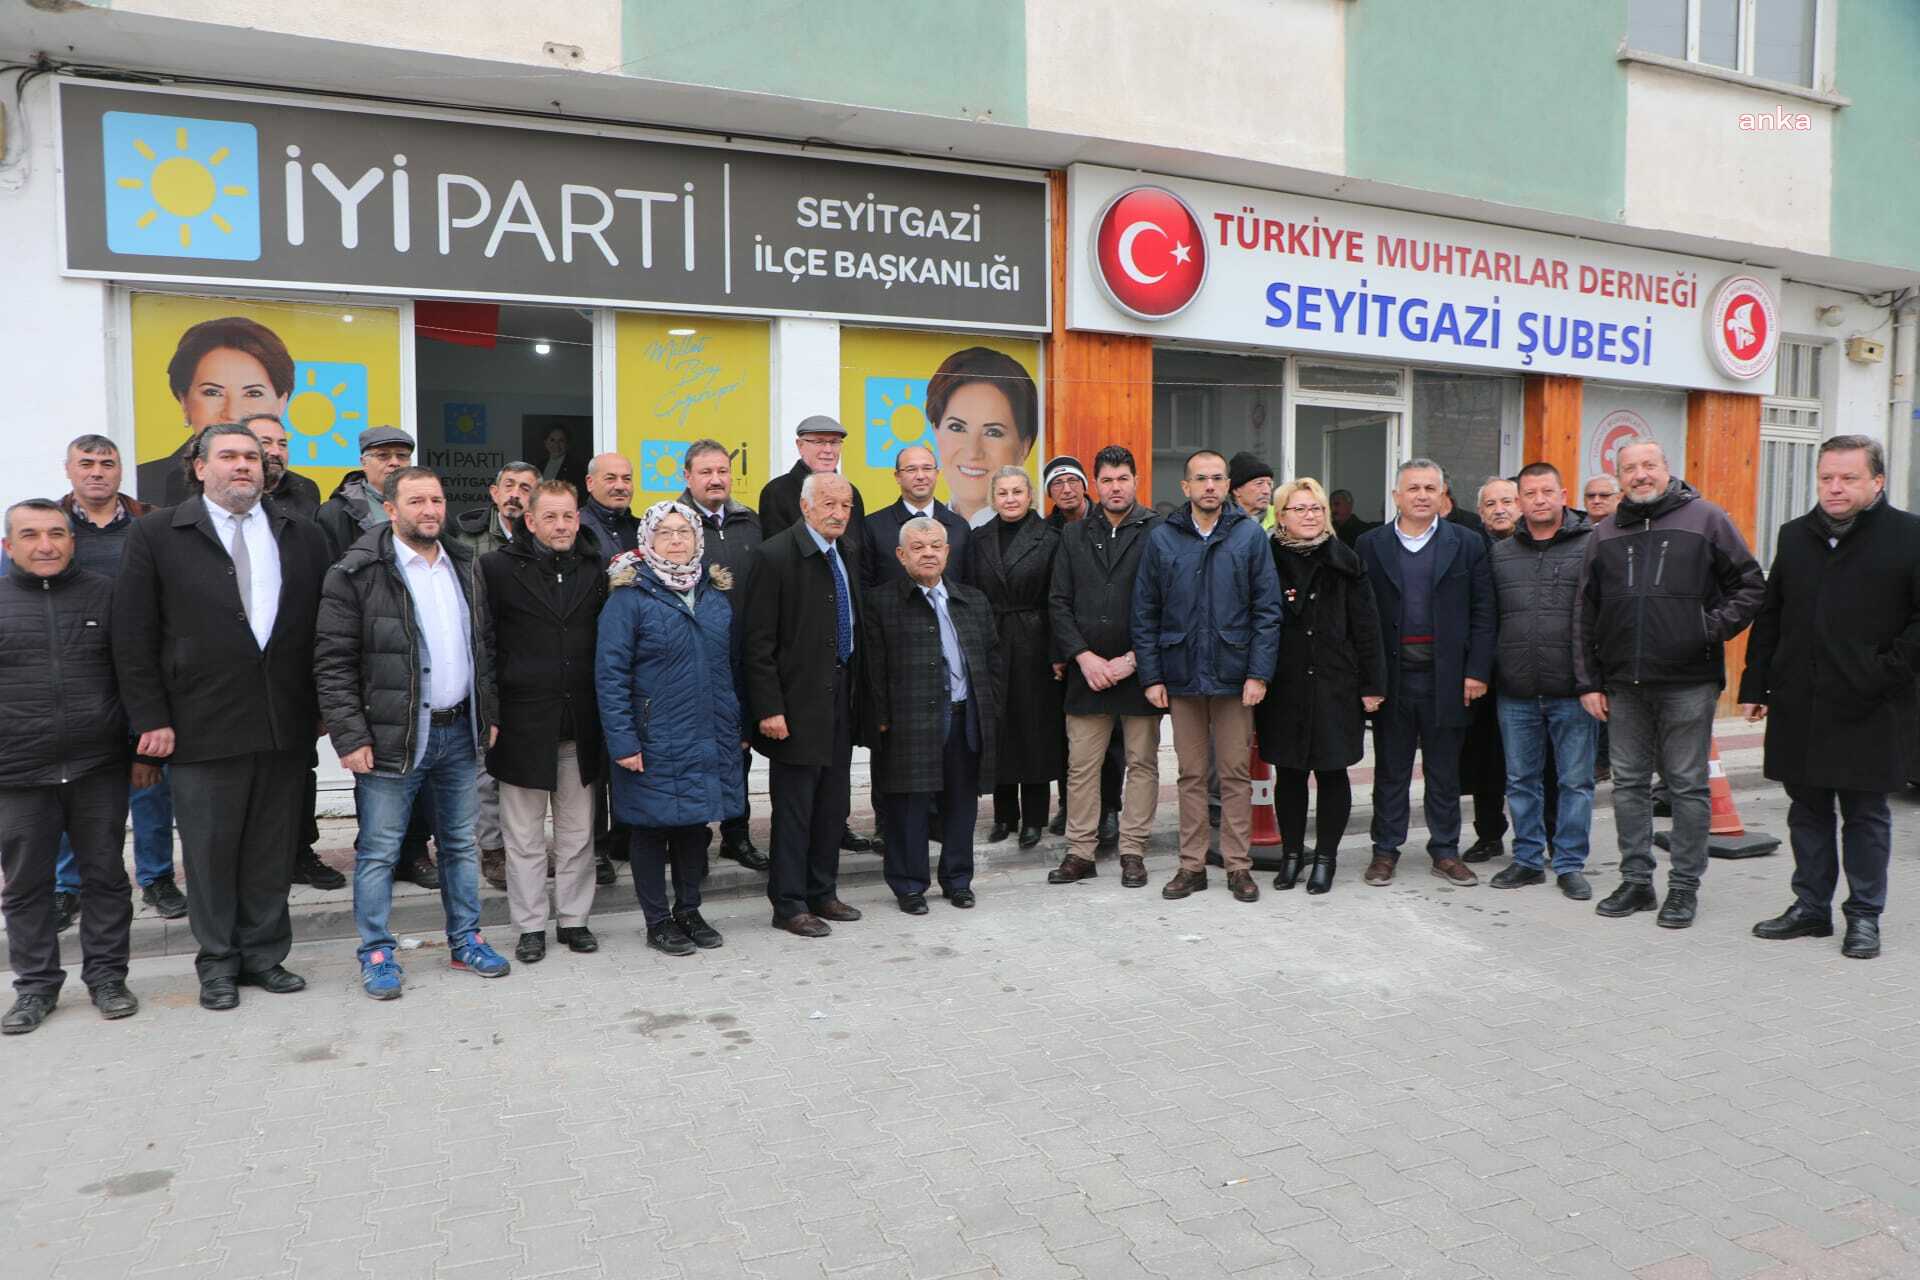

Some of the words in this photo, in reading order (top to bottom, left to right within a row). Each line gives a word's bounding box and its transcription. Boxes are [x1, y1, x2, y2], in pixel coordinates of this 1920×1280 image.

[285, 144, 411, 253] İYİ
[437, 173, 695, 272] PARTİ
[796, 192, 981, 242] SEYİTGAZİ
[754, 234, 828, 283] İLÇE
[834, 251, 1020, 291] BAŞKANLIĞI
[1214, 207, 1364, 264] TÜRKİYE
[1376, 236, 1569, 290] MUHTARLAR
[1579, 266, 1697, 309] DERNEĞİ
[1264, 279, 1502, 349] SEYİTGAZİ
[1517, 311, 1653, 366] ŞUBESİ
[441, 473, 497, 488] EYİTGAZ
